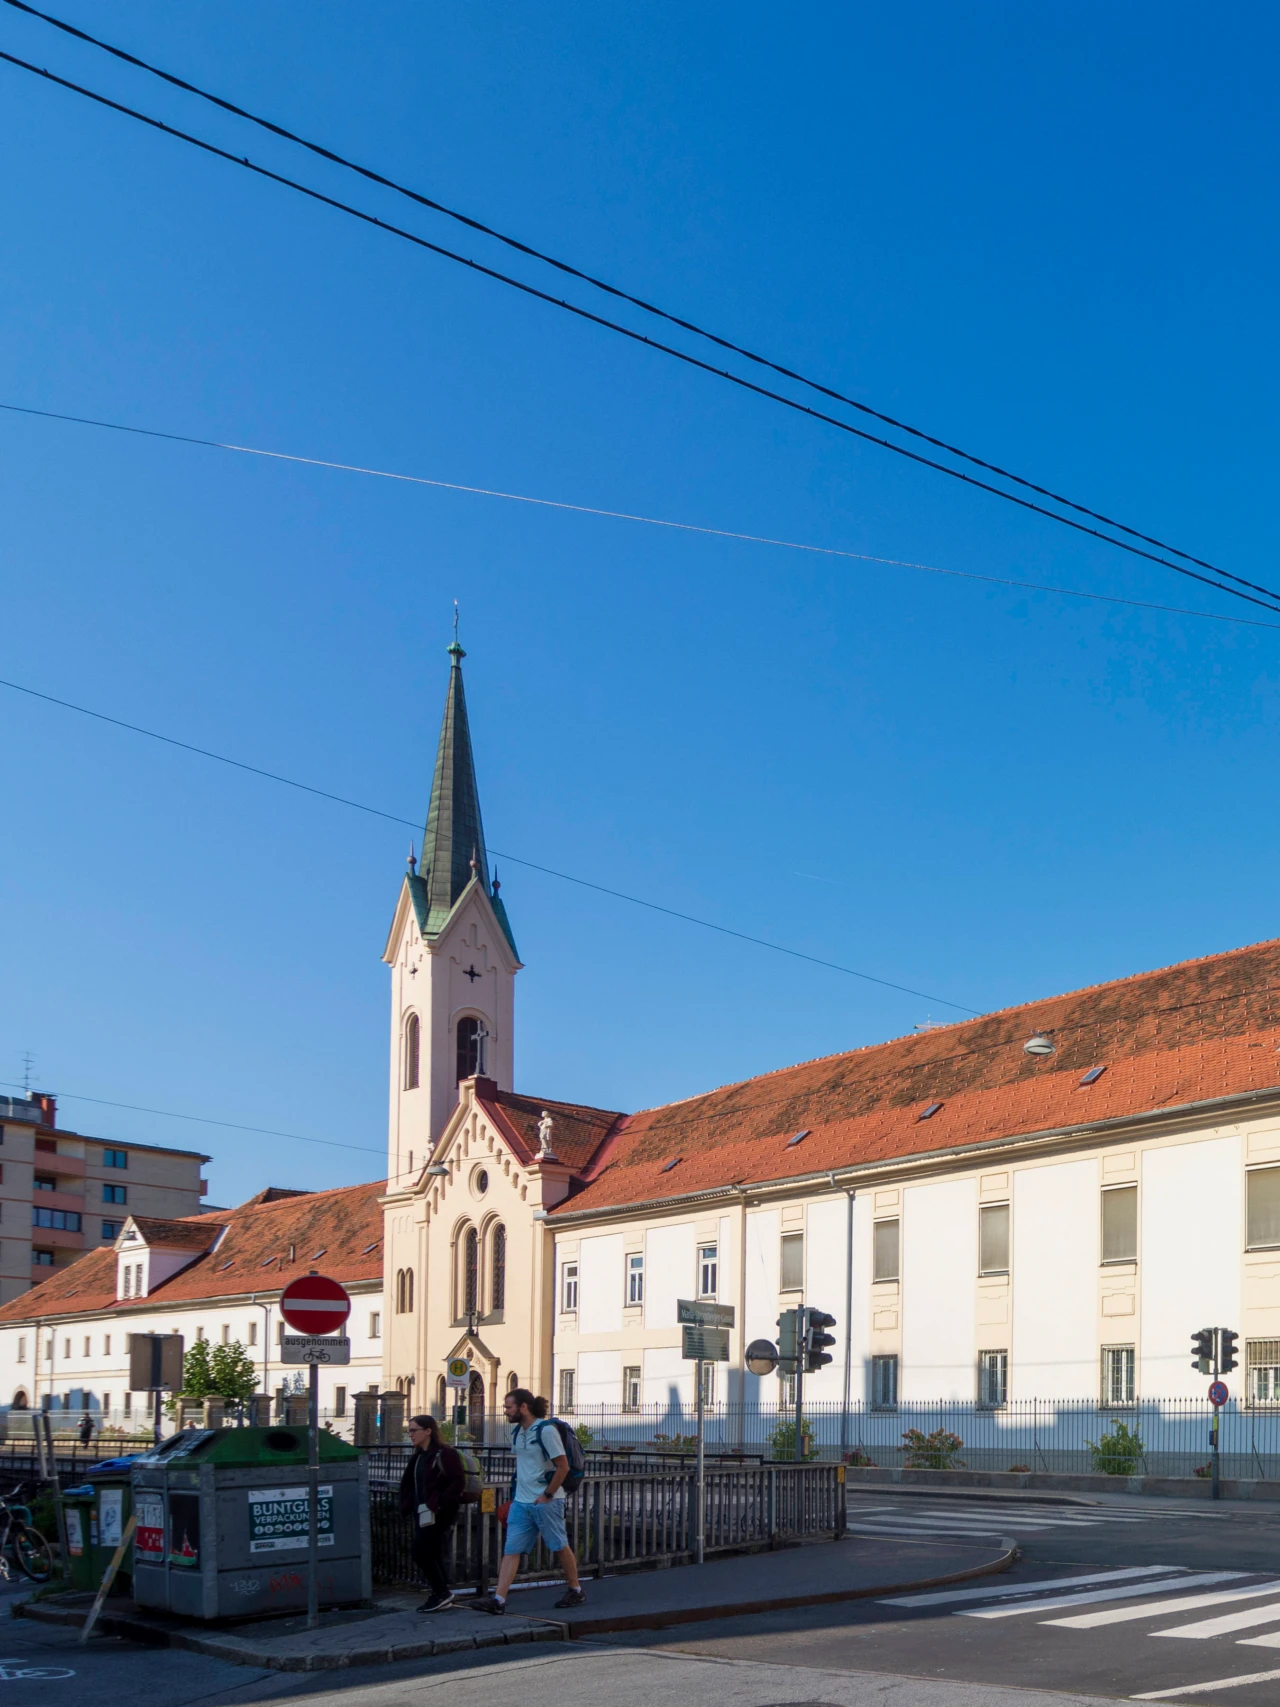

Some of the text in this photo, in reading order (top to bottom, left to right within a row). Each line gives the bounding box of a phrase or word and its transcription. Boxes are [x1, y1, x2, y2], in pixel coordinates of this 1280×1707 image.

[285, 1337, 349, 1348] ausgenommen
[454, 1363, 463, 1373] H
[253, 1499, 330, 1516] BUNTGLS
[254, 1511, 330, 1524] VERPACKUNEN
